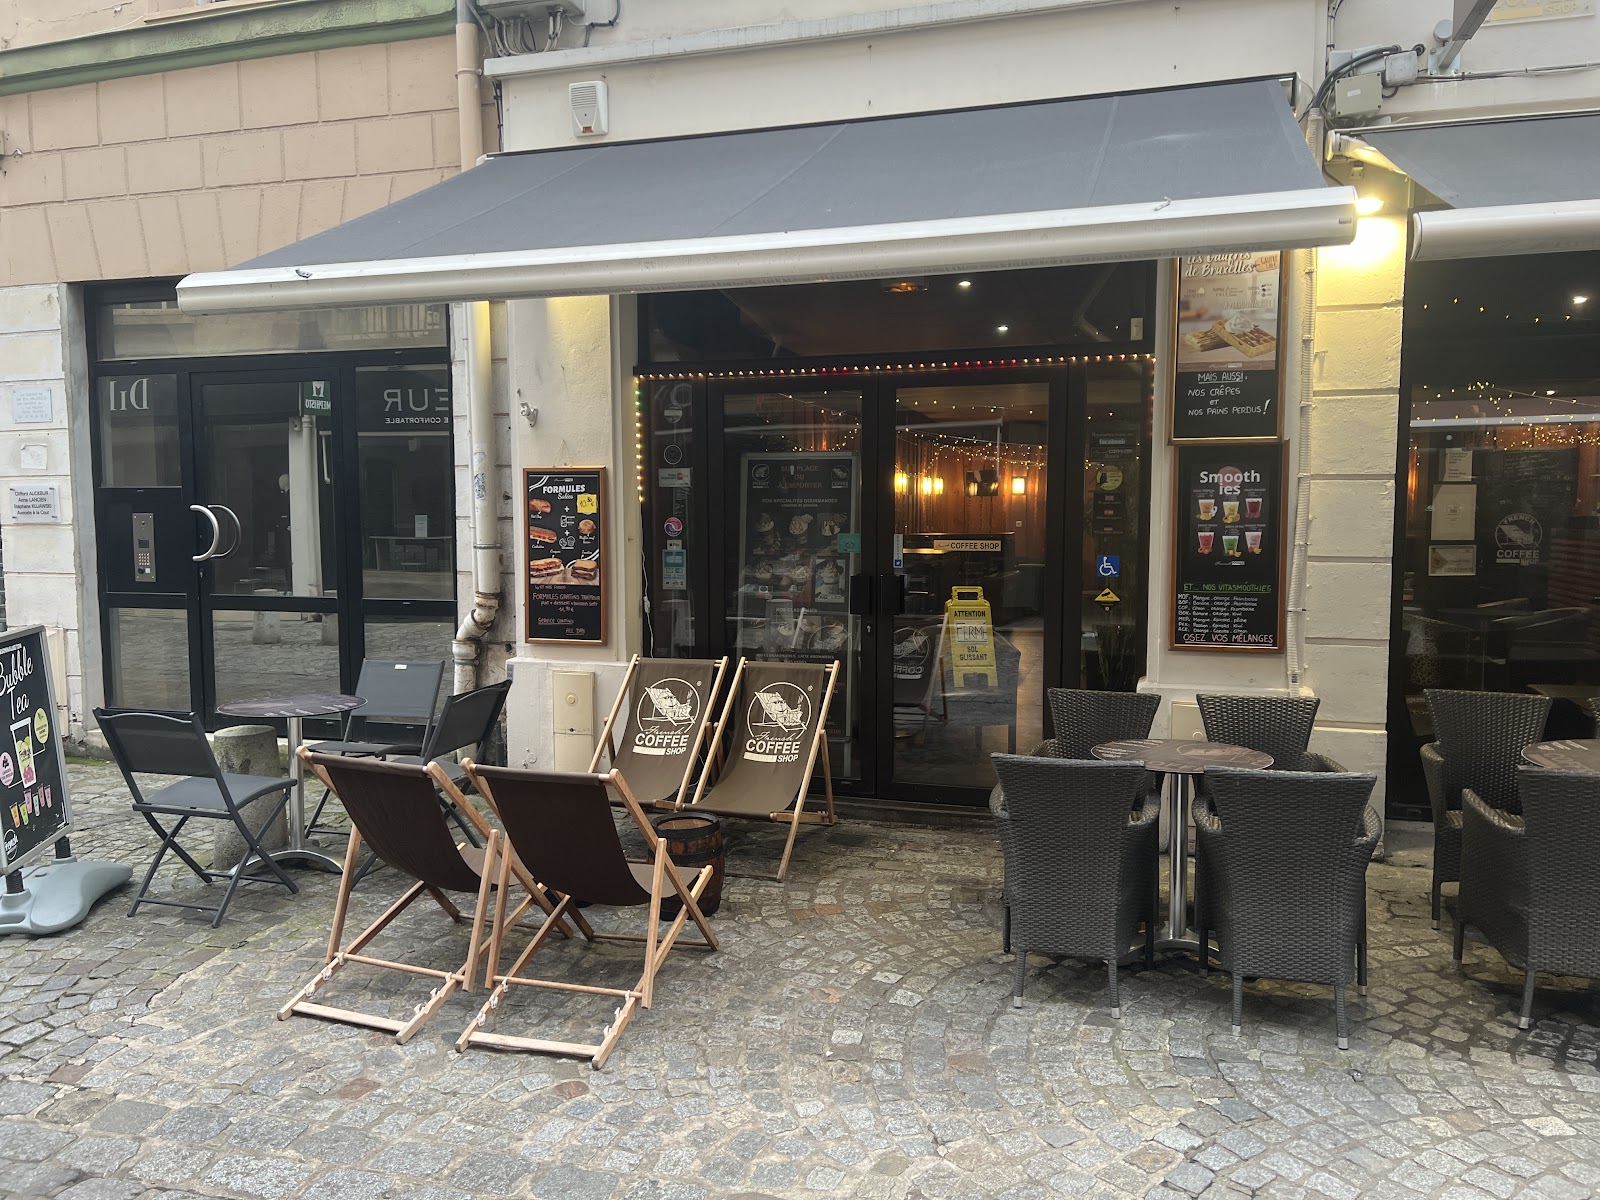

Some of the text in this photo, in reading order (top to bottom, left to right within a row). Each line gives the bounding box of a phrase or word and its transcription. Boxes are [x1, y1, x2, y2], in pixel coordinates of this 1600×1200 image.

[1546, 4, 1577, 14] SHOP
[1185, 260, 1254, 278] de Bruxelles
[1198, 372, 1217, 382] MAIS
[1188, 385, 1241, 397] NOS CRÊPES
[1188, 408, 1203, 416] NOS
[1207, 407, 1229, 416] PAINS
[1232, 405, 1262, 415] PERDUS
[1199, 470, 1260, 484] Smooth
[543, 485, 586, 494] FORMULES
[1219, 482, 1241, 495] ies
[1504, 515, 1536, 525] FRENCH
[1496, 549, 1540, 558] COFFEE
[1202, 583, 1216, 591] NOS
[1183, 633, 1206, 641] OSEZ
[1211, 634, 1228, 642] VOS
[960, 653, 987, 661] GLISSANT
[7, 686, 29, 720] Tea
[634, 733, 690, 748] COFFEE
[666, 746, 687, 756] SHOP
[745, 738, 801, 754] COFFEE
[777, 754, 799, 763] SHOP
